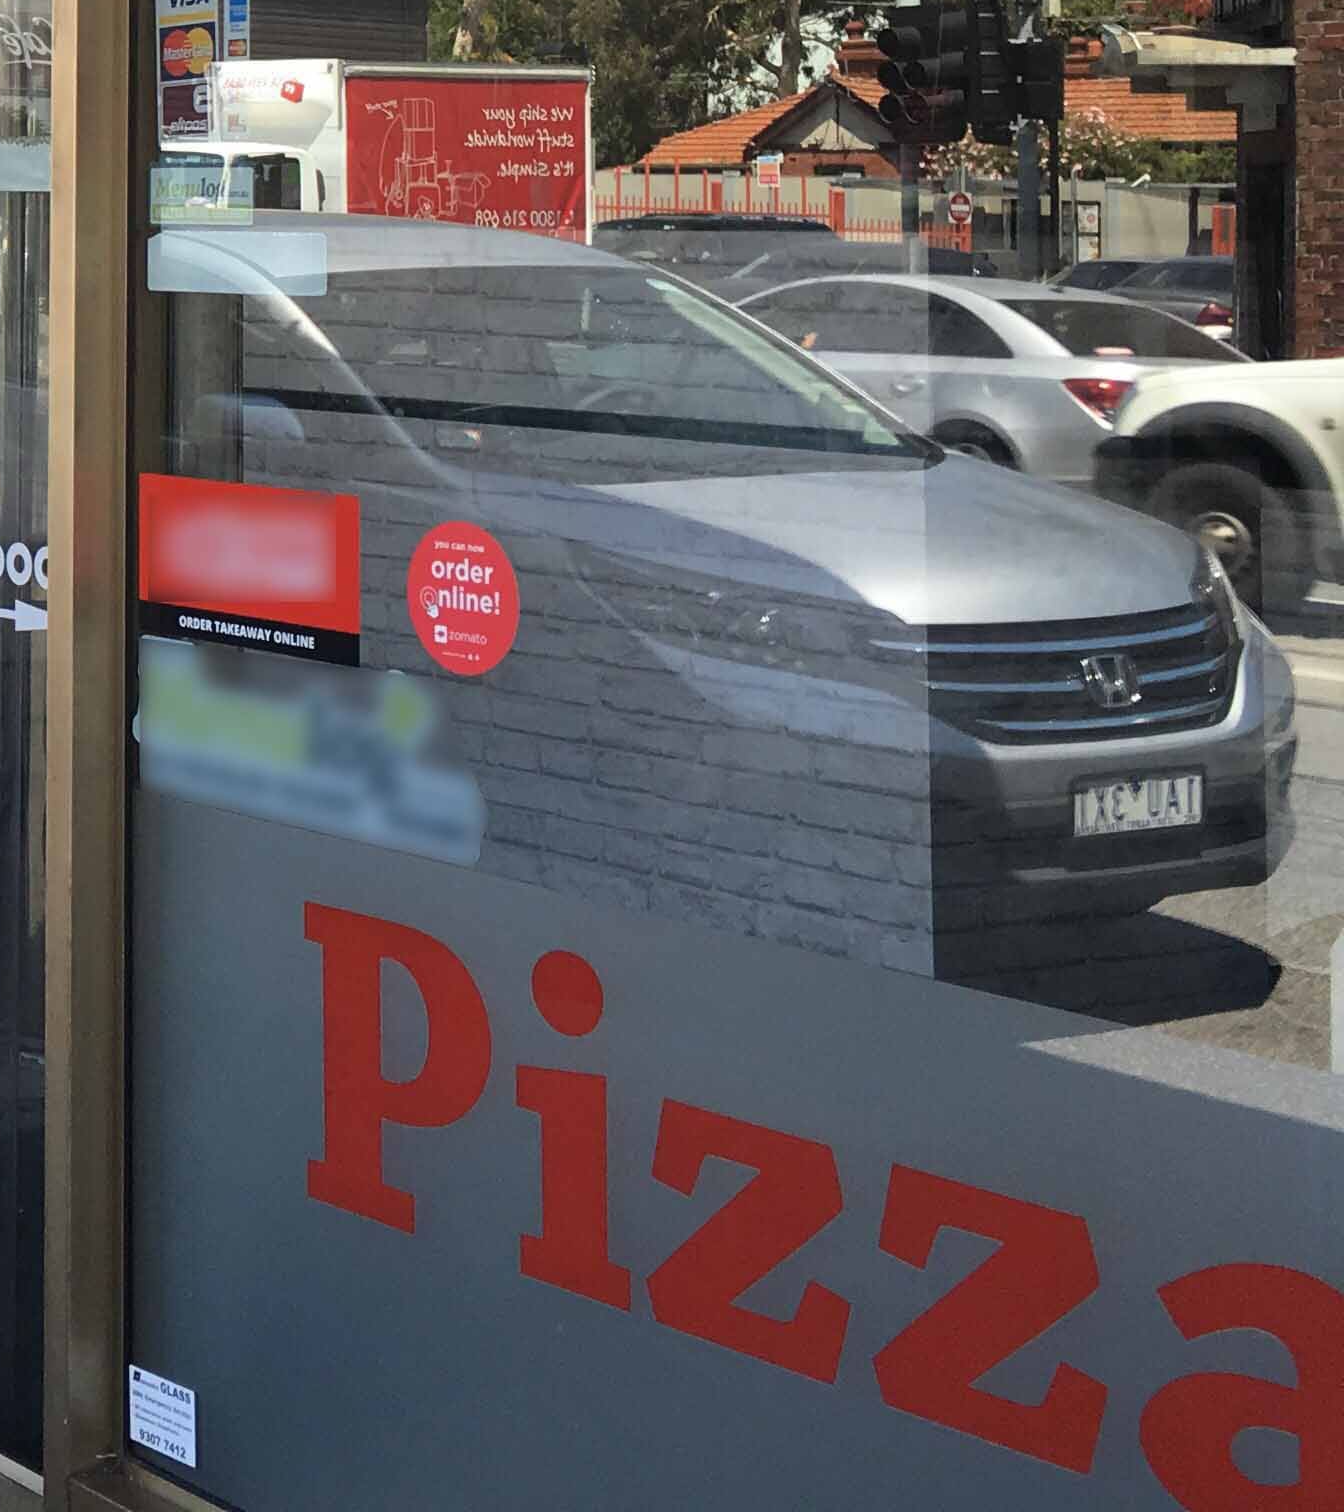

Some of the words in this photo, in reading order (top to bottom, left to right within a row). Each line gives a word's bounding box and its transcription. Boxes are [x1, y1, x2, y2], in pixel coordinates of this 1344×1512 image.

[431, 558, 495, 585] order
[179, 614, 213, 633] ORDER
[214, 618, 272, 643] TAKEAWAY
[273, 631, 316, 650] ONLINE
[449, 631, 488, 645] zomato
[303, 899, 1344, 1512] Pizza
[159, 1381, 192, 1405] GLASS
